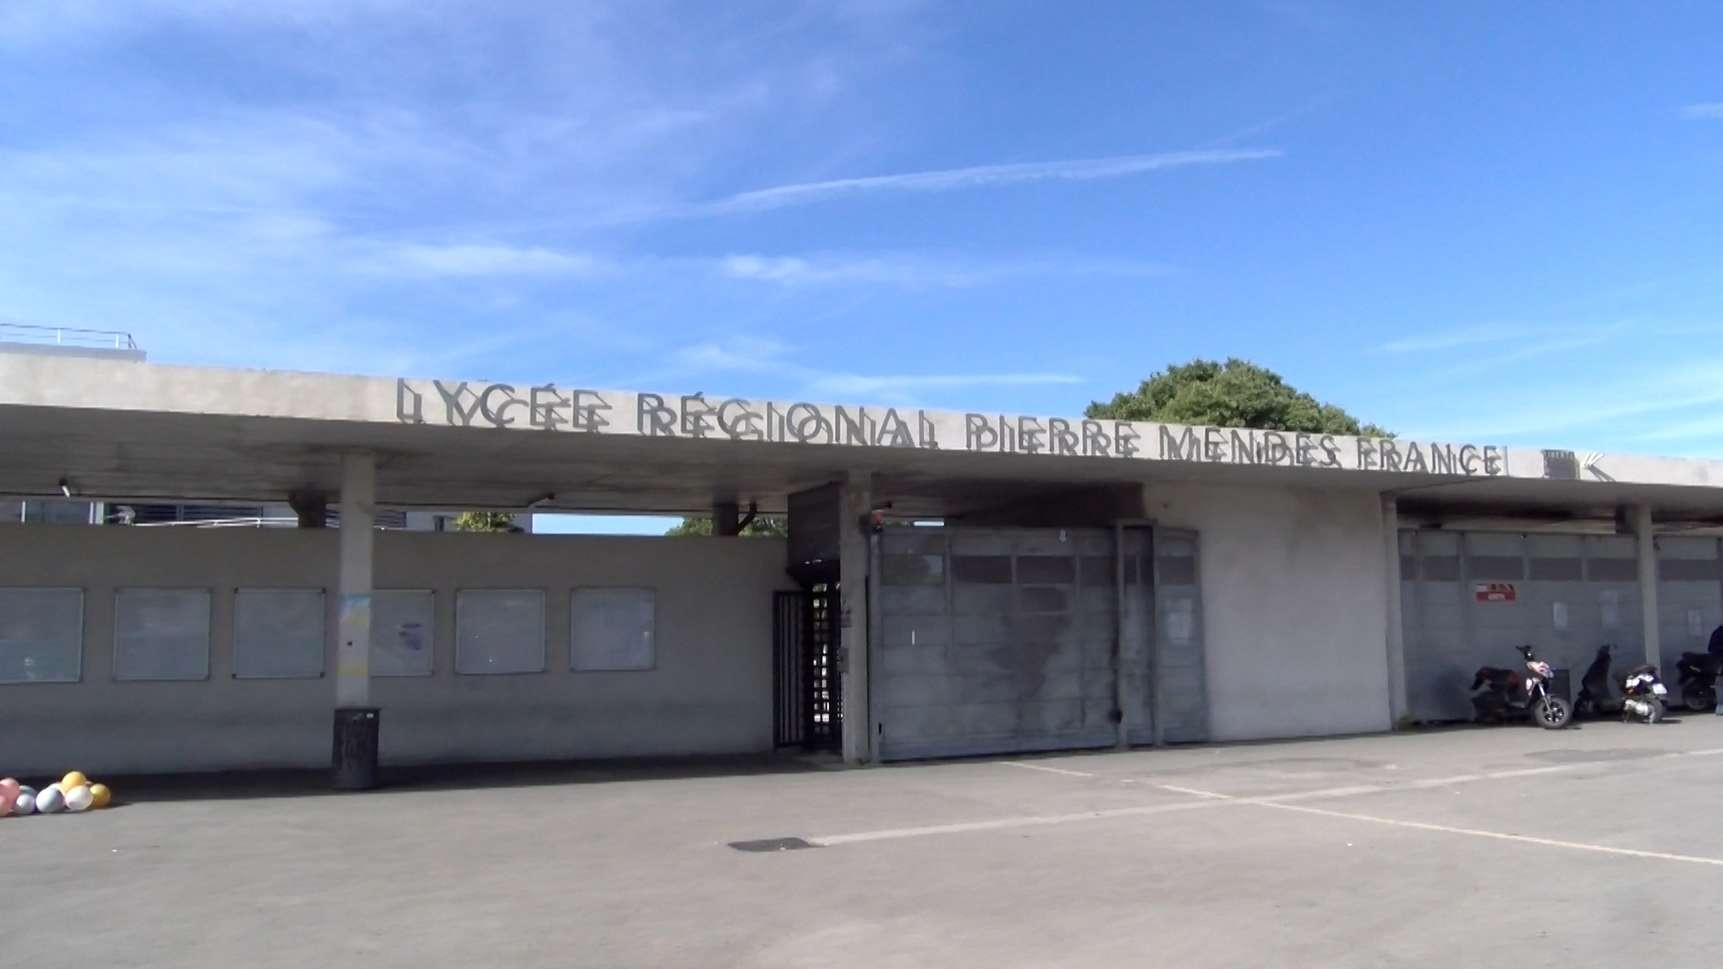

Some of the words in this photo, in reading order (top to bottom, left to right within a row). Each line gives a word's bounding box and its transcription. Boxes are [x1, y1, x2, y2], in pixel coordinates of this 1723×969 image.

[396, 378, 609, 430] LYCÉE
[637, 391, 938, 447] RÉGIONAL
[965, 413, 1137, 457] PIERRE
[1357, 437, 1502, 476] FRANCE
